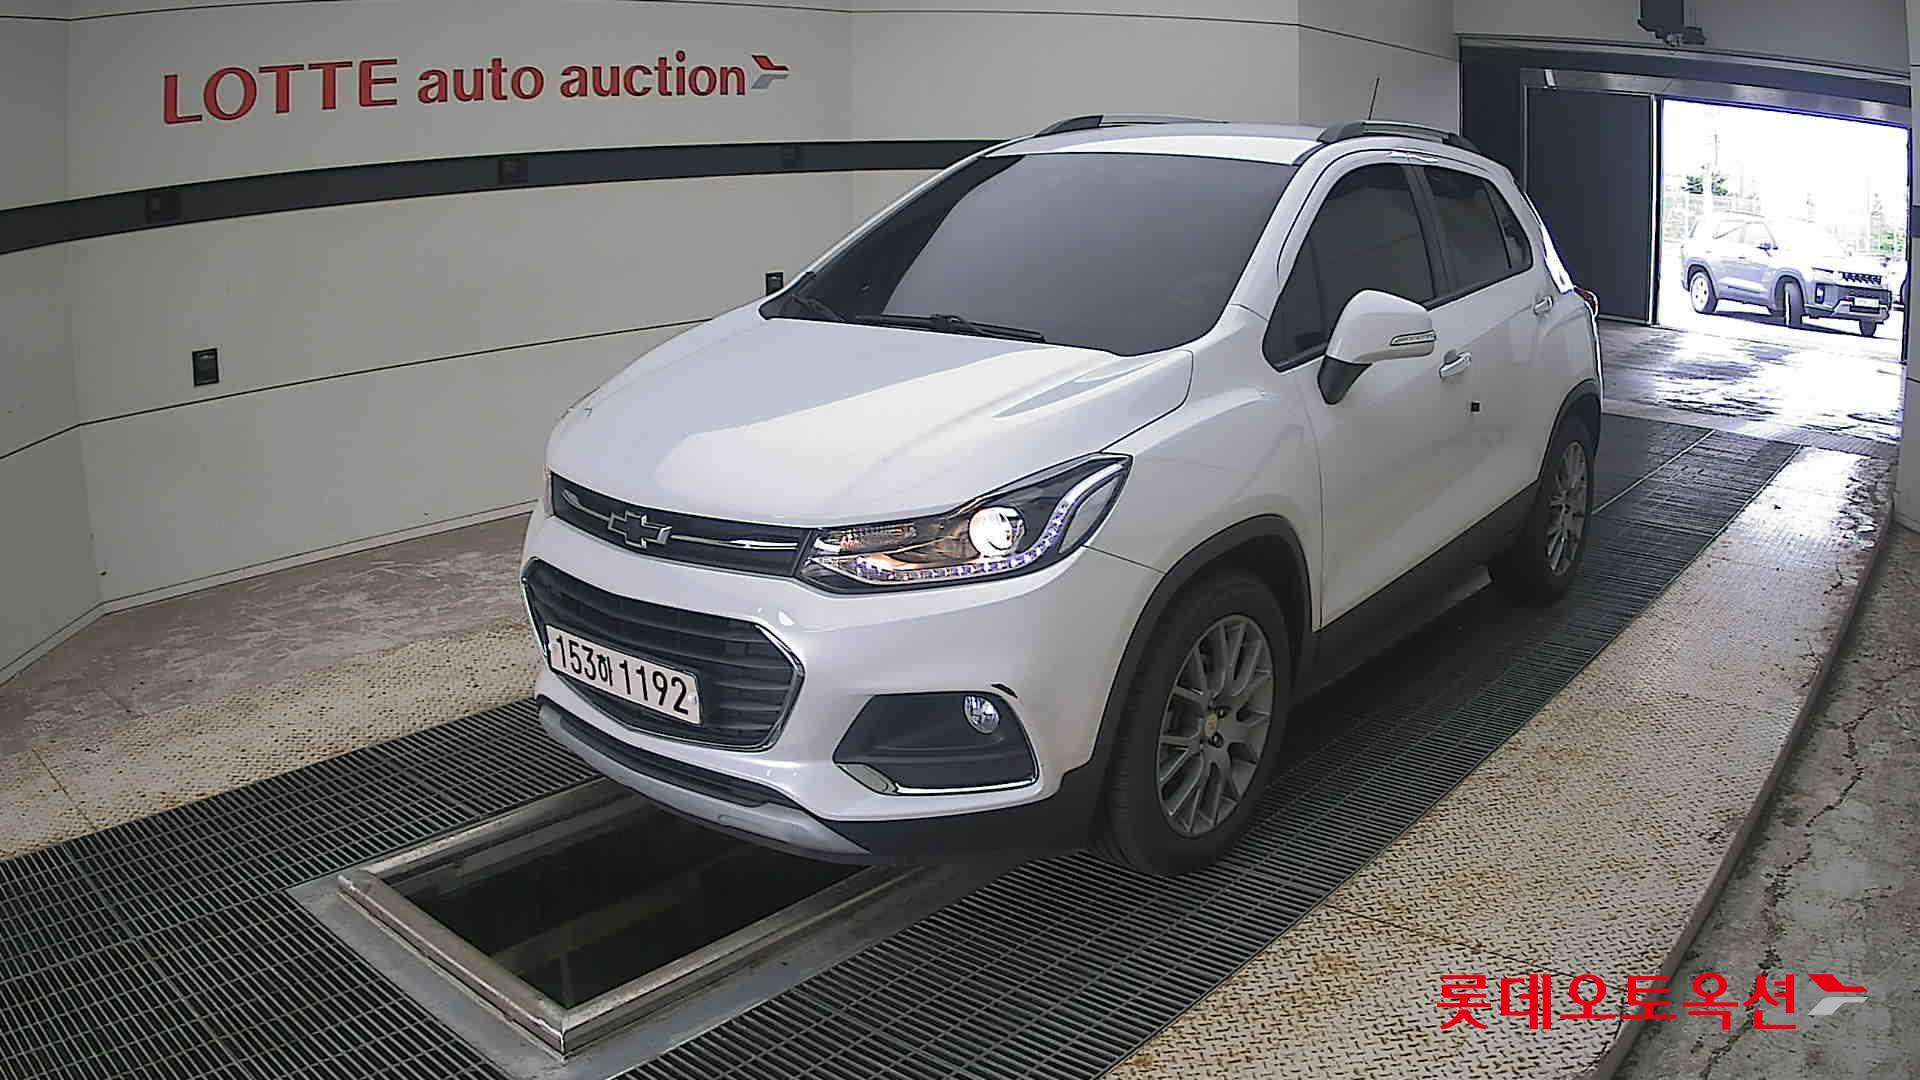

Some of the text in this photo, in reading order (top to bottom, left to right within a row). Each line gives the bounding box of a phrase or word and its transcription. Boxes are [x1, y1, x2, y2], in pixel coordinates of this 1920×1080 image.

[163, 50, 747, 125] LOTTE auto auction
[619, 659, 689, 716] 1192
